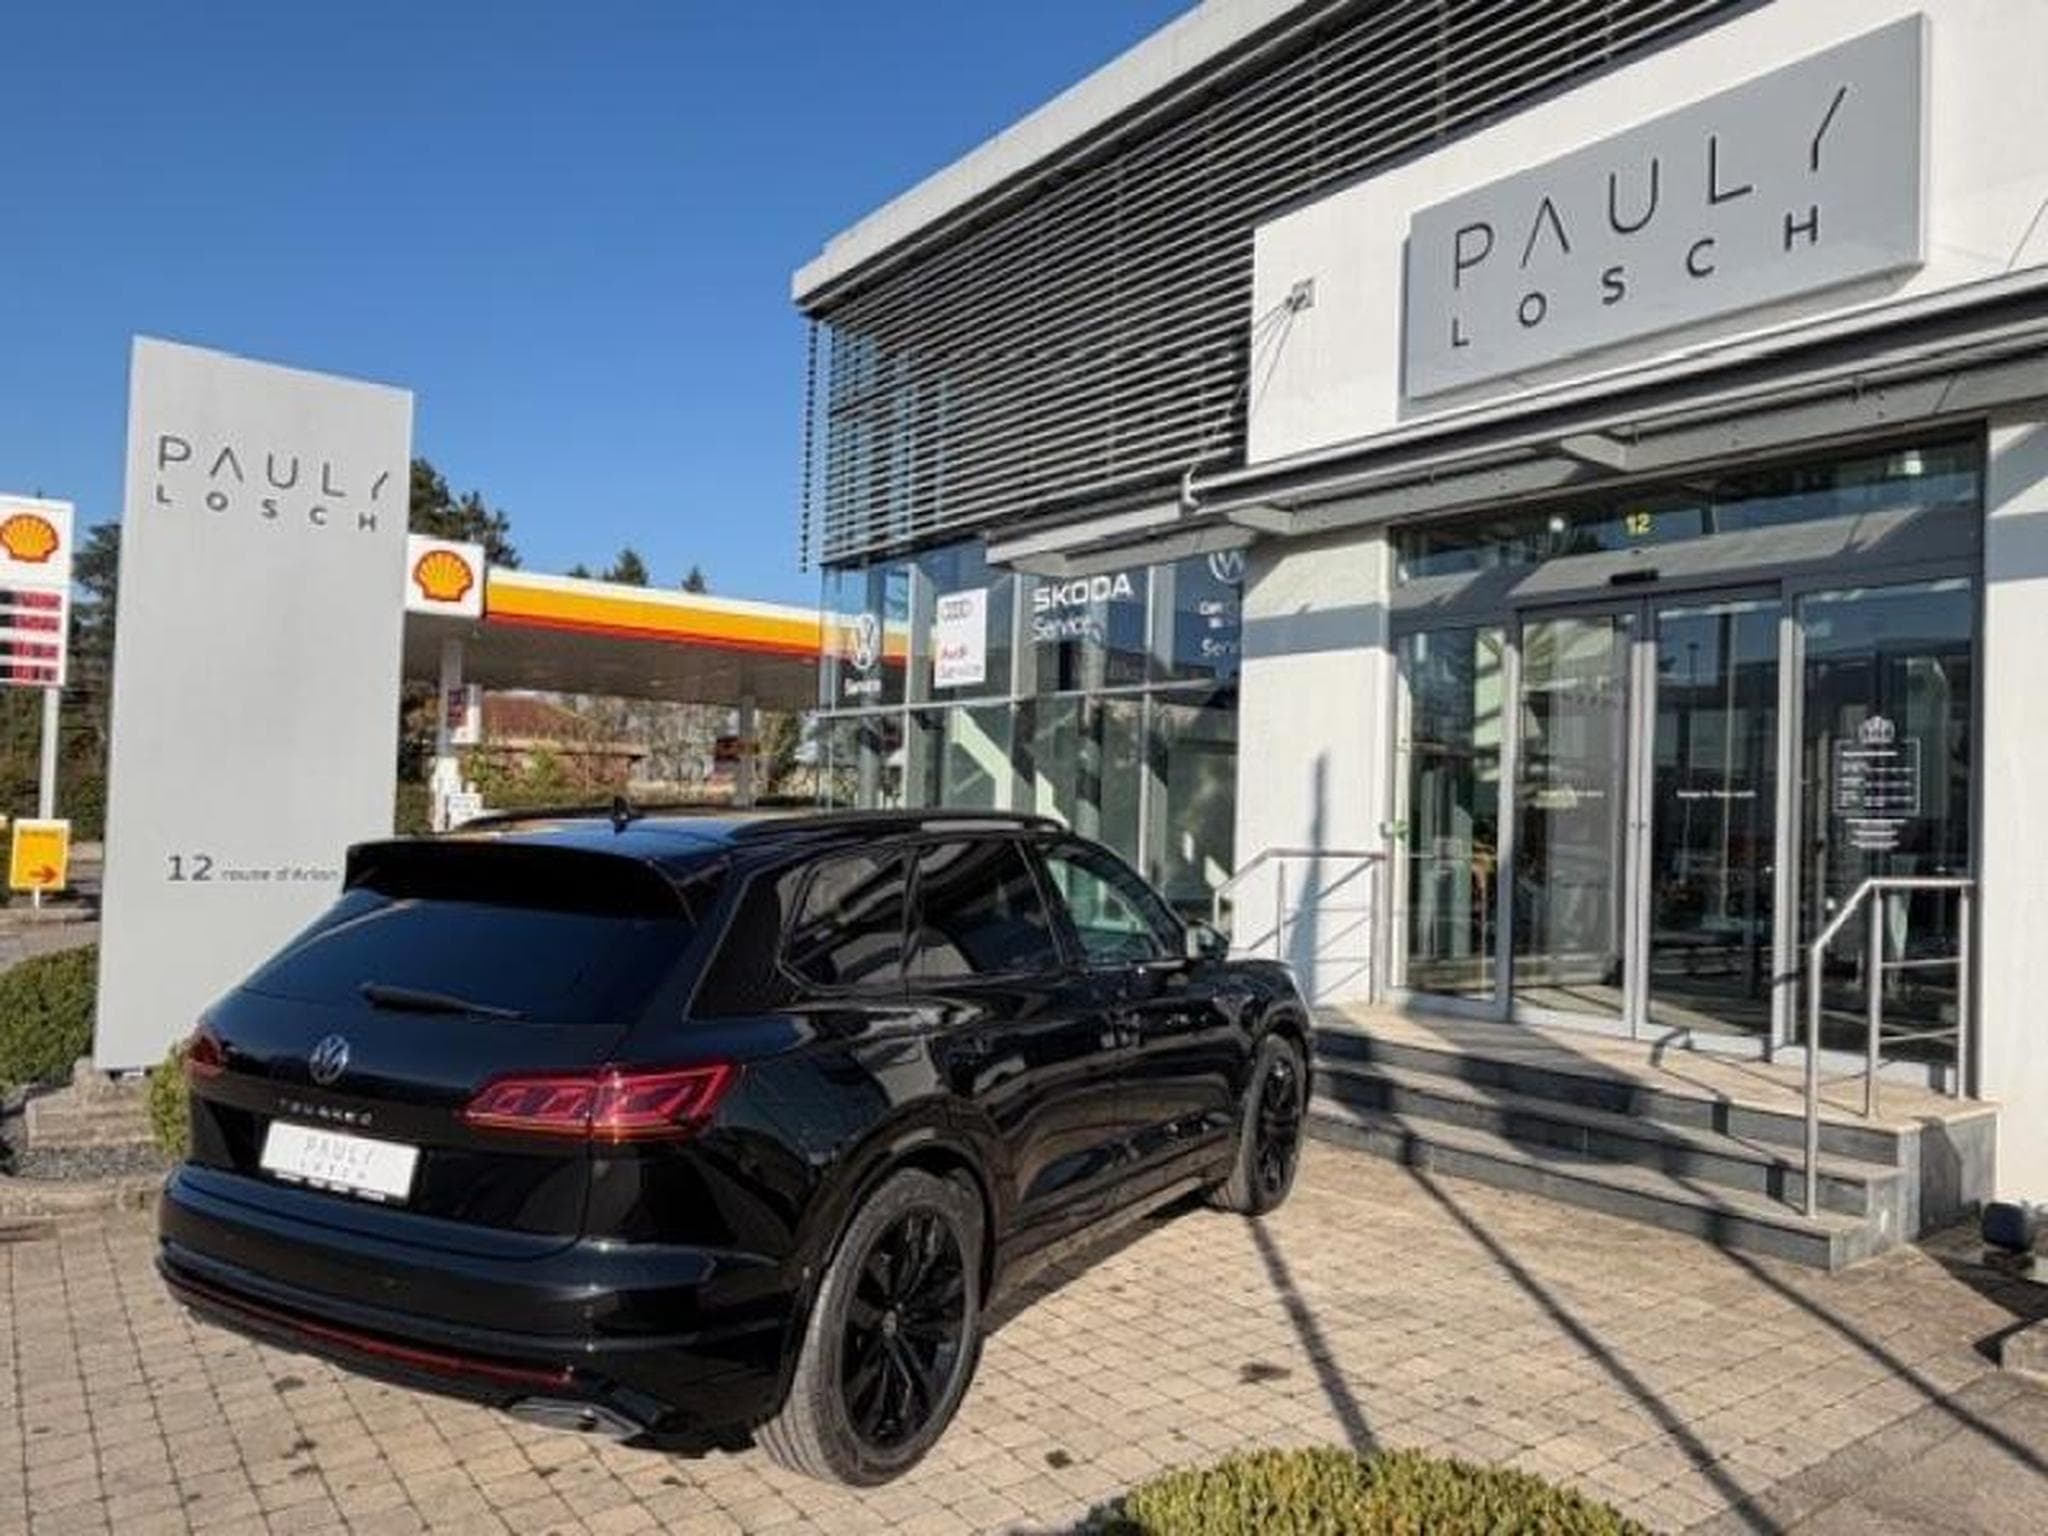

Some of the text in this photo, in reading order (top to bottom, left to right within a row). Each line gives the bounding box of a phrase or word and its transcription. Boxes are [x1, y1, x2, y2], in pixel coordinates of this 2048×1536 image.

[1454, 84, 1848, 290] PAULY
[1451, 204, 1819, 349] LOSCH
[158, 434, 389, 501] PAULY
[156, 483, 377, 533] LOSCH
[1626, 512, 1650, 536] 12
[167, 853, 213, 882] 12
